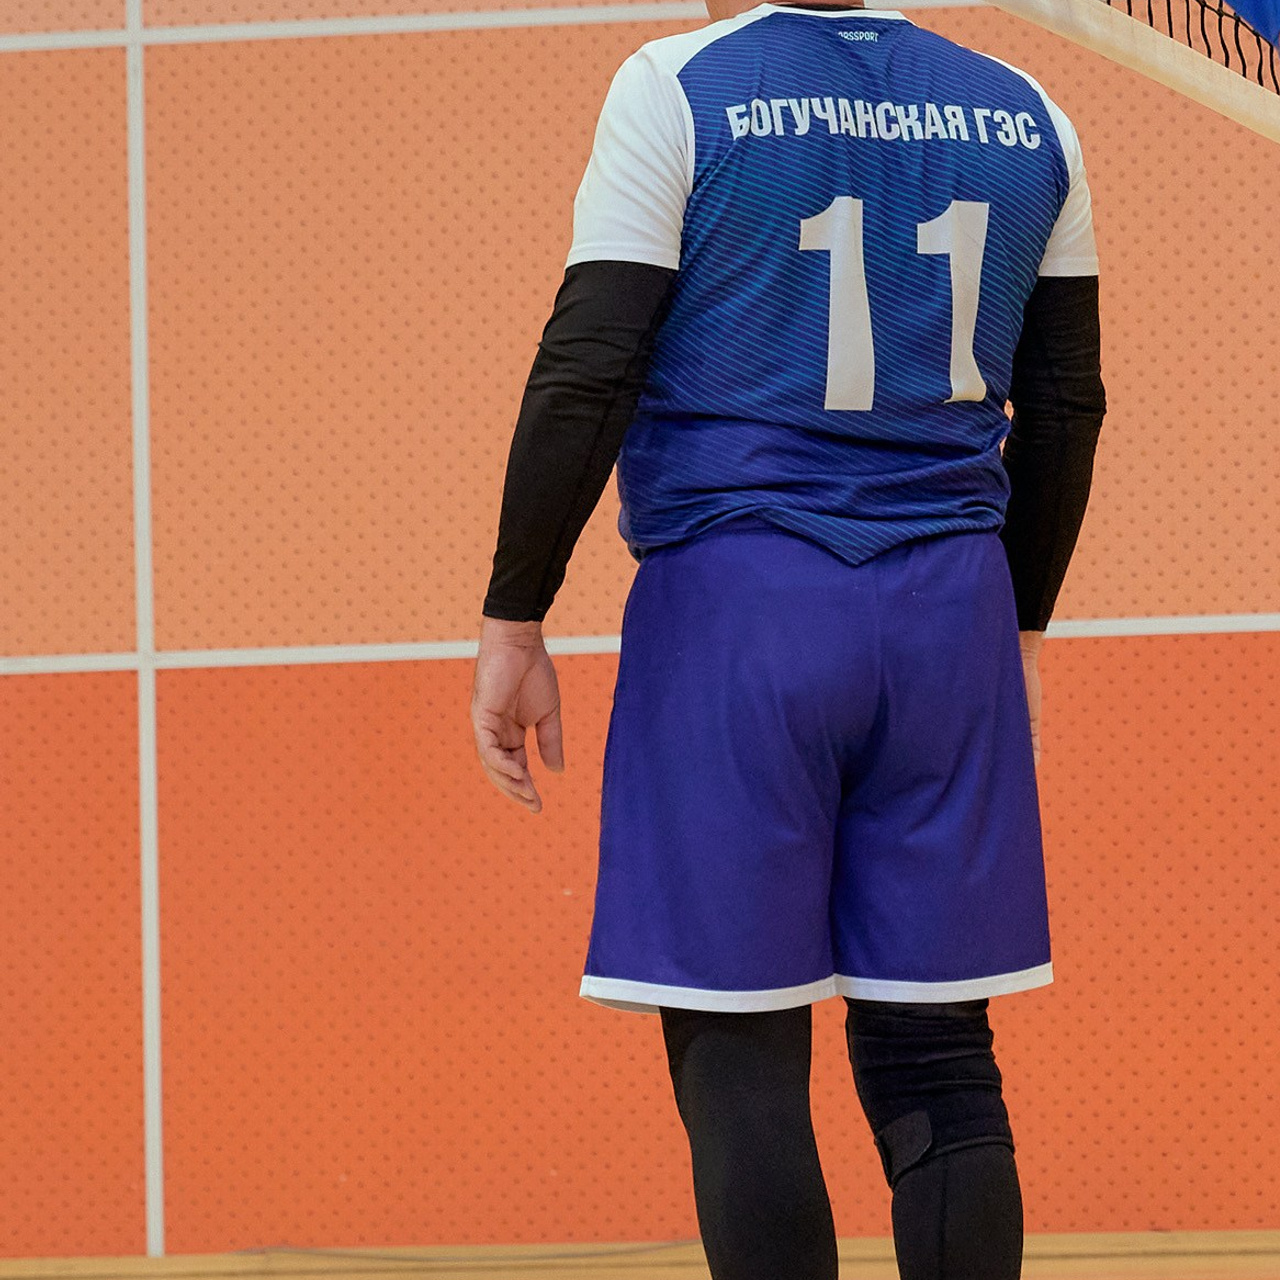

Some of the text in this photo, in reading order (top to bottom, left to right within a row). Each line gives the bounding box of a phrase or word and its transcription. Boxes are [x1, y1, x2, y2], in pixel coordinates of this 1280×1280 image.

[726, 97, 1041, 149] БОГУЧАНСКАЯ ГЭС
[798, 196, 990, 411] 11
